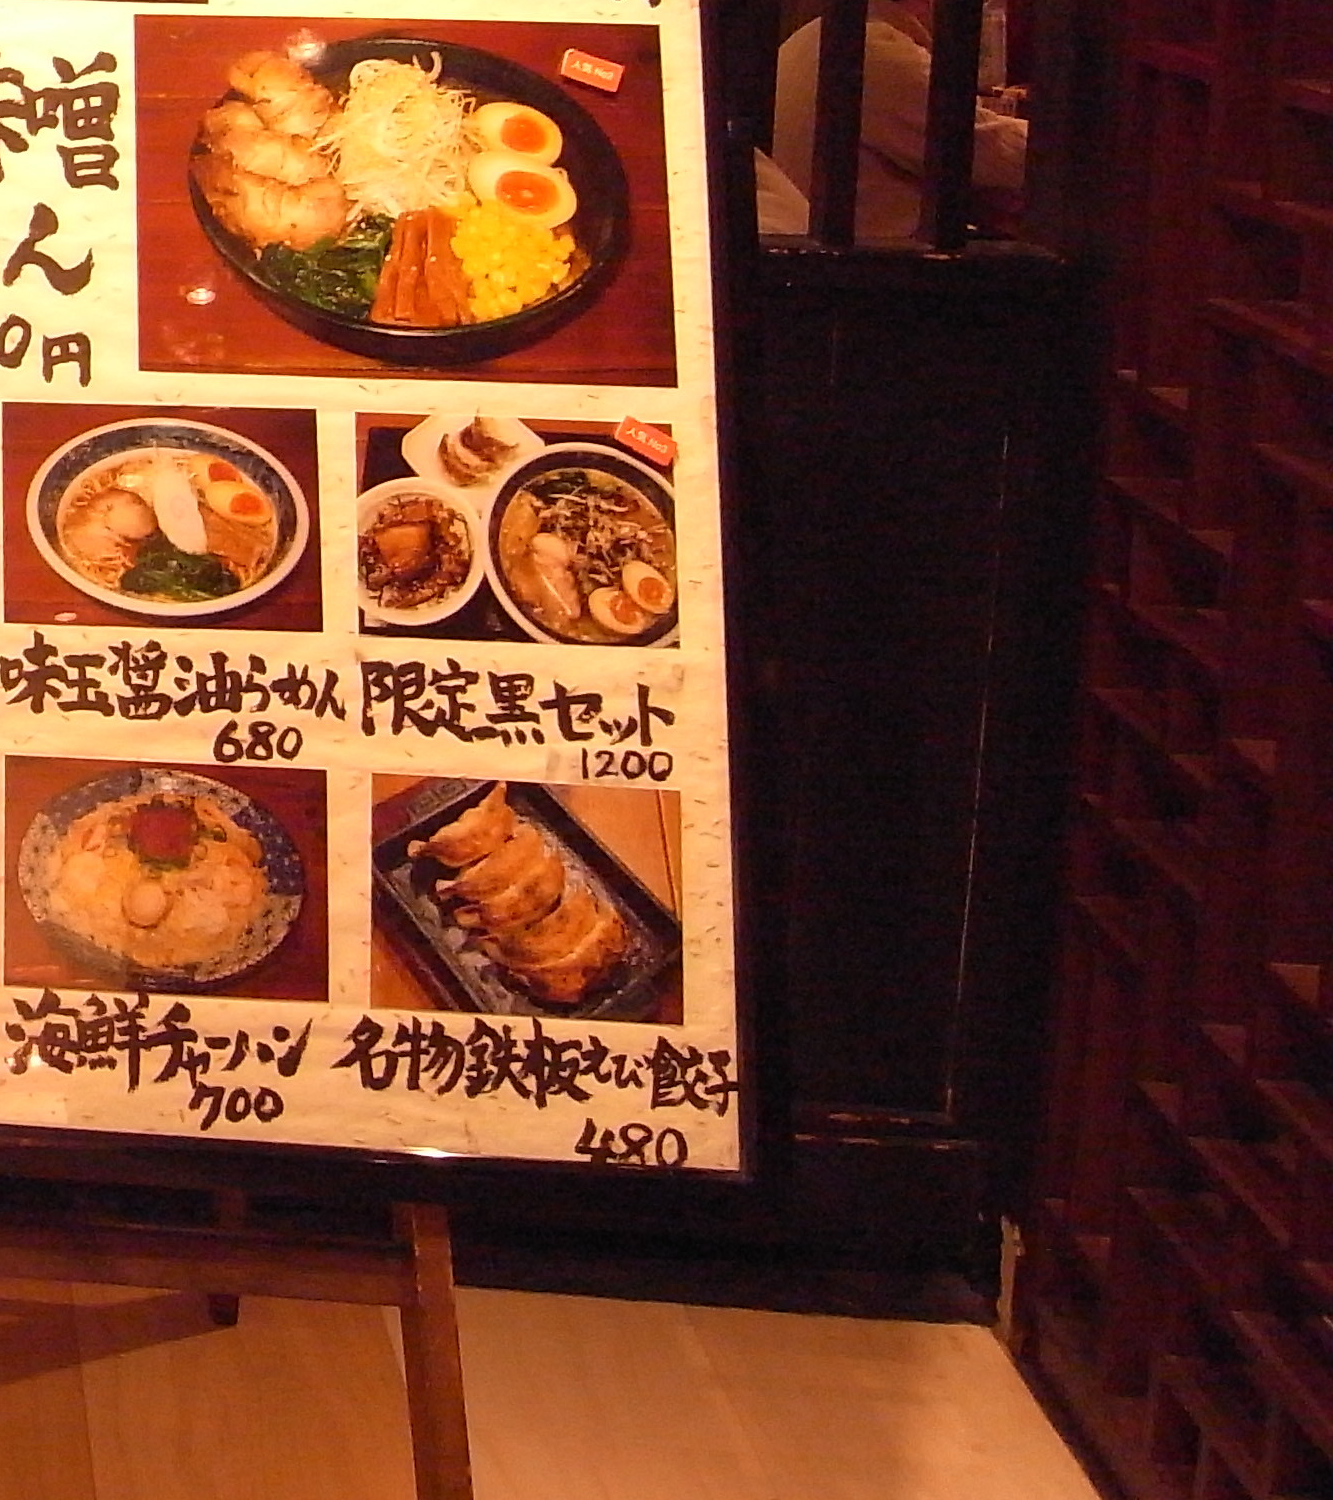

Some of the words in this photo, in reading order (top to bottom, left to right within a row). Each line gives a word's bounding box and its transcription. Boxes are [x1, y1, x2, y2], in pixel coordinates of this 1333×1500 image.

[360, 657, 676, 748] 限定黒セット
[212, 719, 304, 763] 680
[581, 748, 674, 782] 1200
[188, 1081, 285, 1131] 700
[574, 1117, 688, 1166] 480
